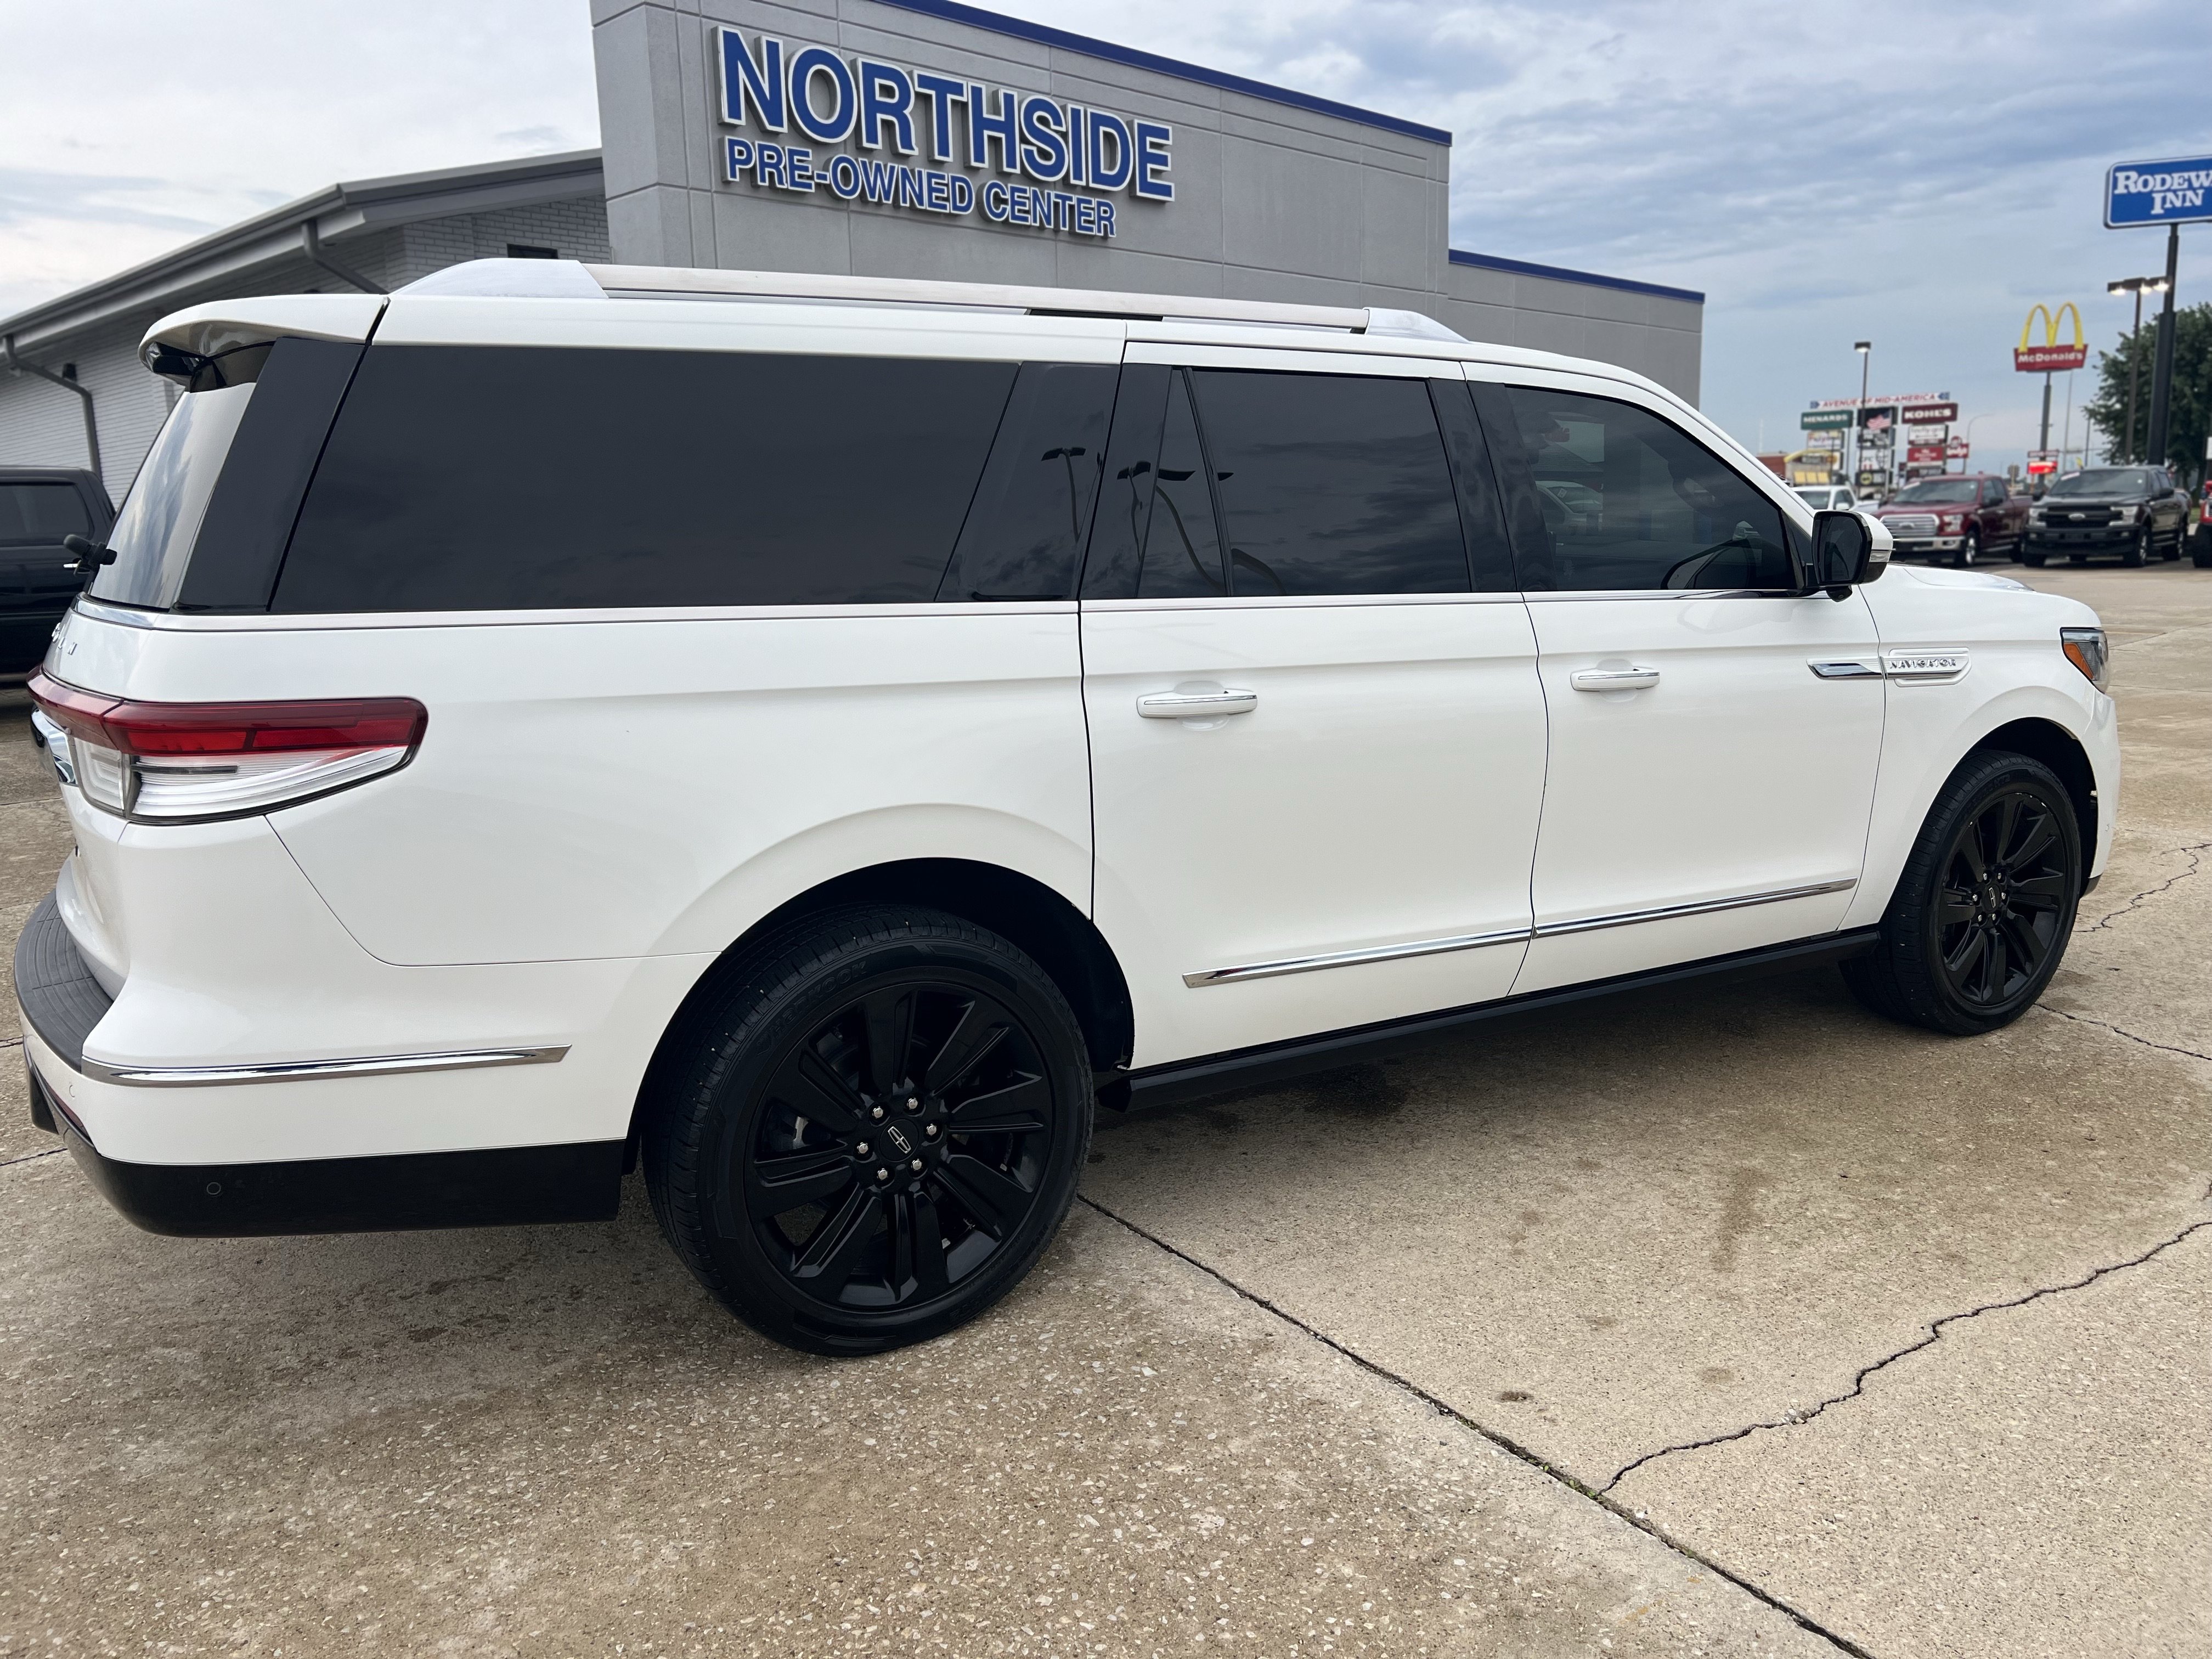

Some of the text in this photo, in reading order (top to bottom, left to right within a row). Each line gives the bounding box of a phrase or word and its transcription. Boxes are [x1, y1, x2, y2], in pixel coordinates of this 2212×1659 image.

[713, 26, 1176, 203] NORTHSIDE
[722, 136, 1117, 239] PRE-OWNED CENTER
[2114, 171, 2212, 194] RODEW
[2151, 189, 2204, 215] INN
[2018, 352, 2083, 363] McDonald's
[1822, 399, 1857, 408] AVENUE
[1875, 393, 1935, 404] MID-AMERICA
[1803, 414, 1848, 422] MENARDS
[1905, 409, 1951, 419] KOHL'S
[1889, 658, 1956, 669] NAVIGATOR
